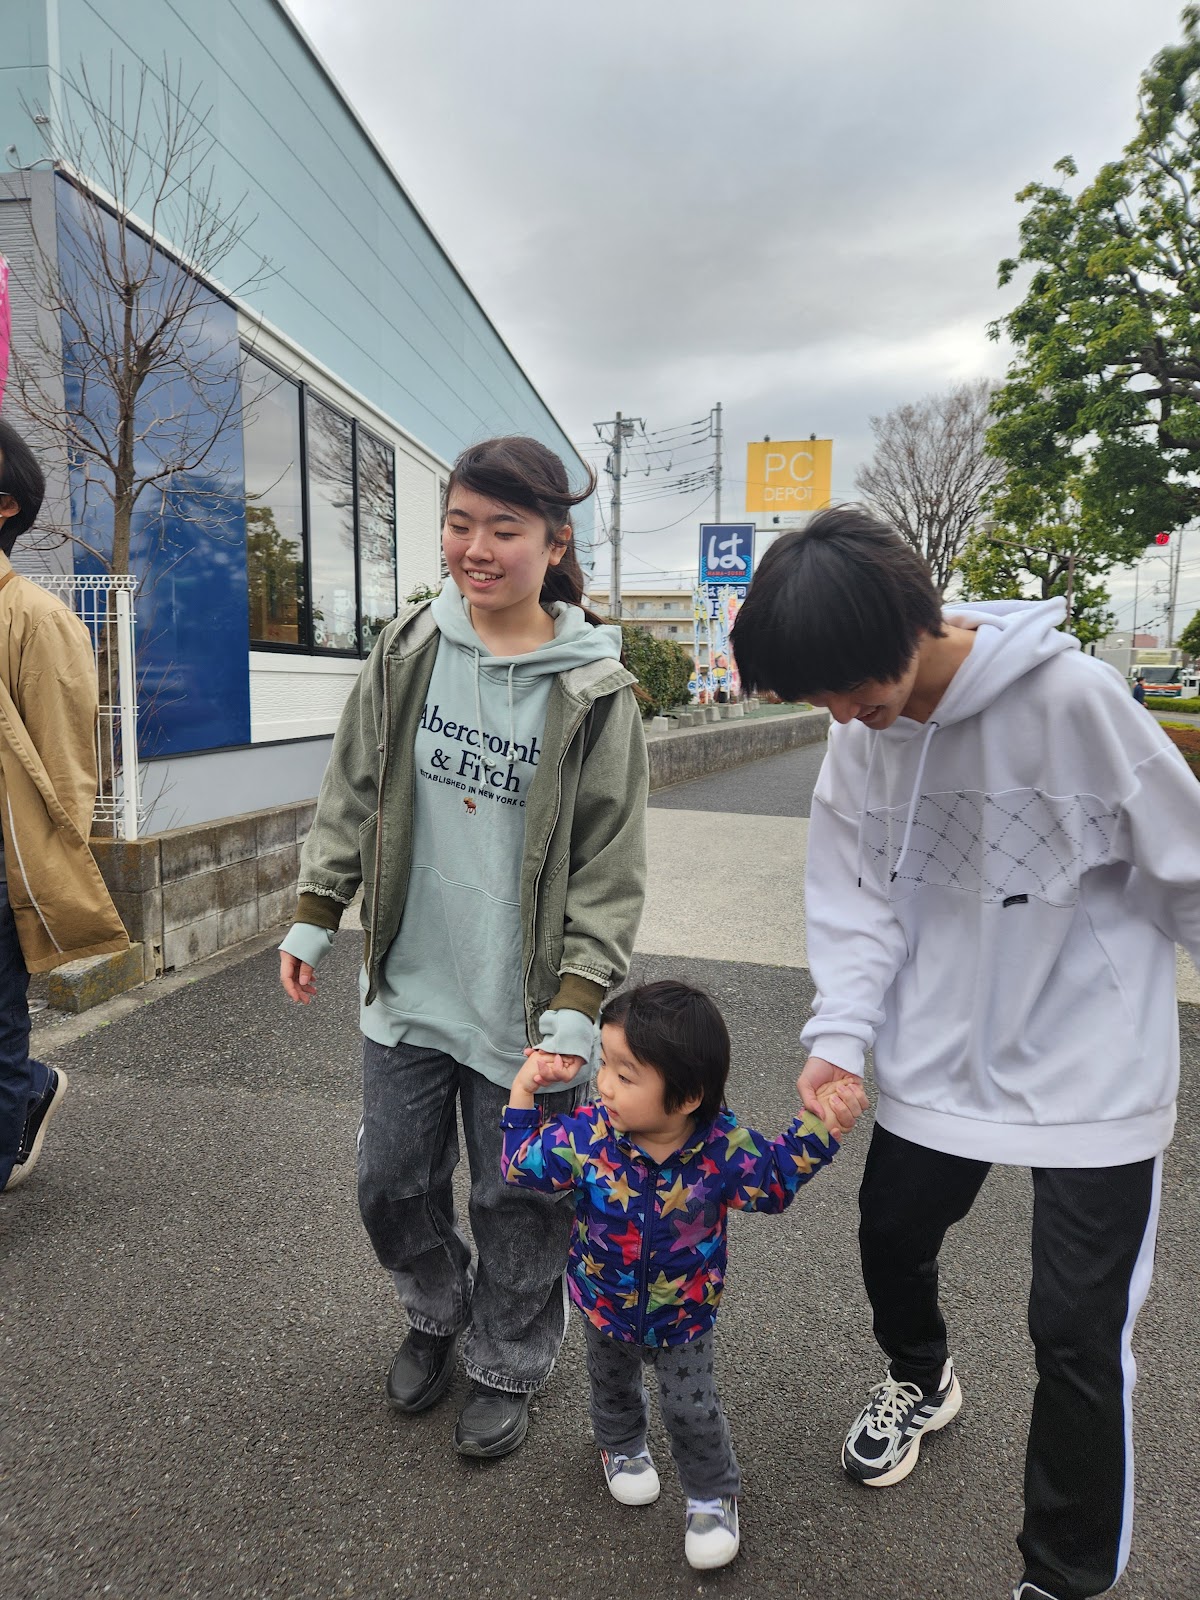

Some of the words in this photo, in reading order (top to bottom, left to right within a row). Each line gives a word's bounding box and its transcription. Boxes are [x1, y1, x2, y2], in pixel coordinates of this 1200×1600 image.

[765, 451, 814, 483] PC
[764, 486, 813, 502] DEPOT
[707, 532, 747, 570] は
[430, 748, 452, 771] &
[468, 785, 476, 795] IN
[478, 788, 495, 800] NEW
[496, 794, 518, 806] YORK
